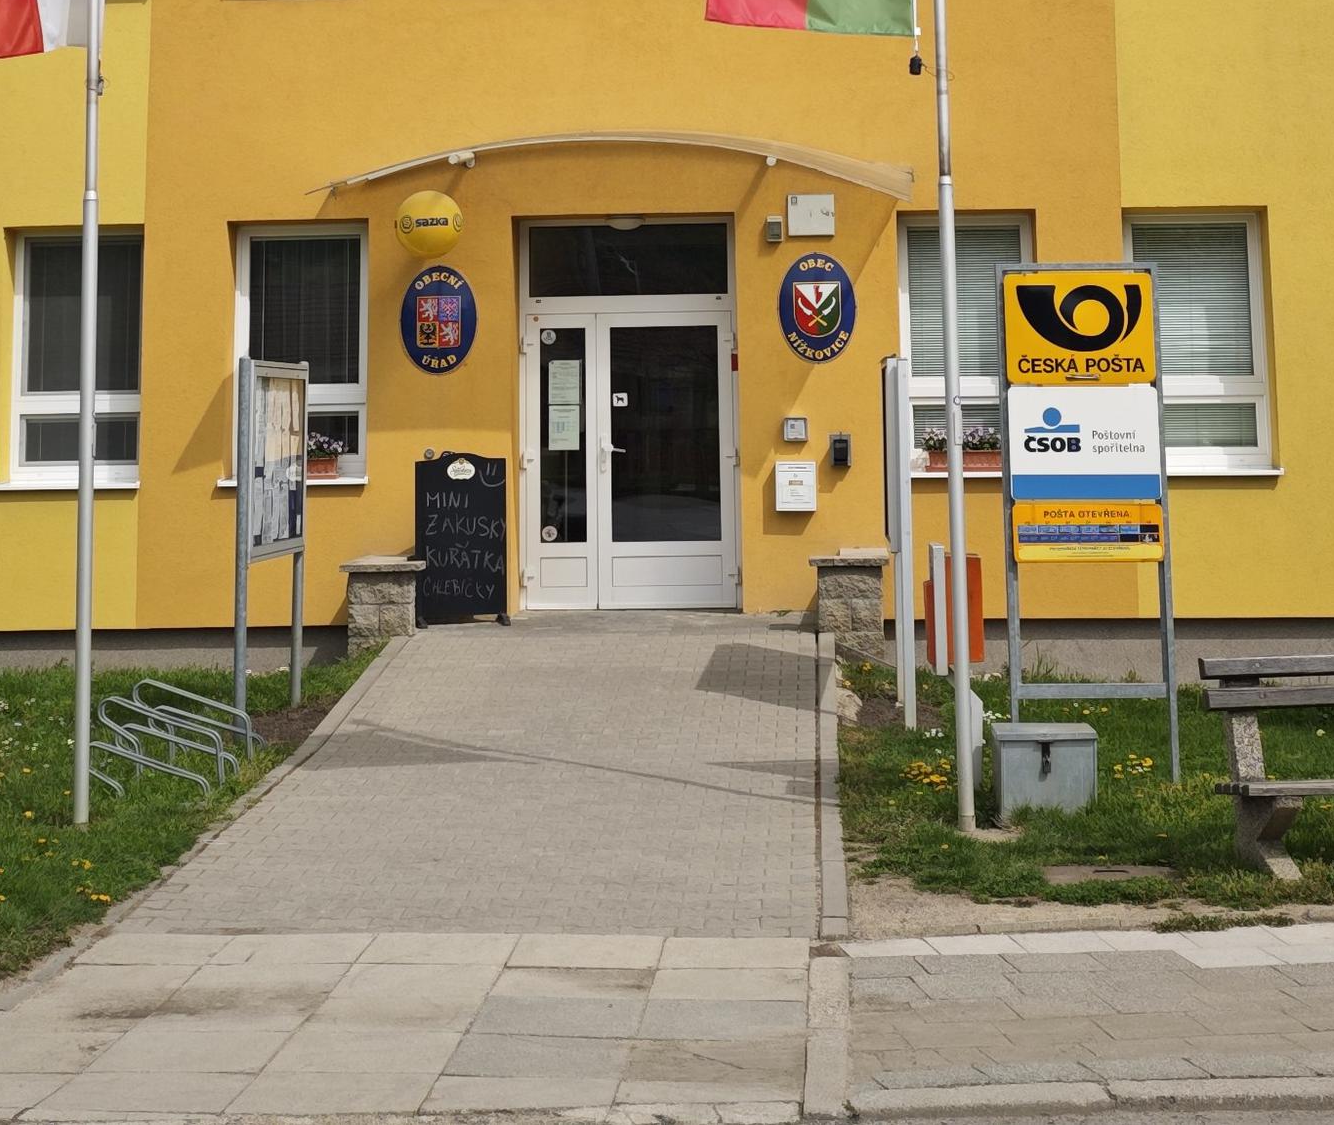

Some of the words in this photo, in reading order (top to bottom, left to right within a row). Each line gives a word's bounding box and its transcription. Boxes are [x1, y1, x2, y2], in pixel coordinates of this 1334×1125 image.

[799, 258, 835, 272] OBEC
[414, 272, 465, 291] OBECNÍ
[787, 330, 850, 360] NÍŽKOVICE
[421, 354, 457, 369] ÚŘAD
[1018, 354, 1079, 373] ČESKÁ
[1085, 354, 1145, 373] POŠTA
[1092, 430, 1137, 440] Poštovní
[1024, 435, 1082, 453] ČSOB
[1092, 442, 1146, 455] spořitelna
[426, 491, 469, 509] MINI
[1043, 508, 1075, 519] POŠTA
[1078, 508, 1130, 519] OTEVŘENA
